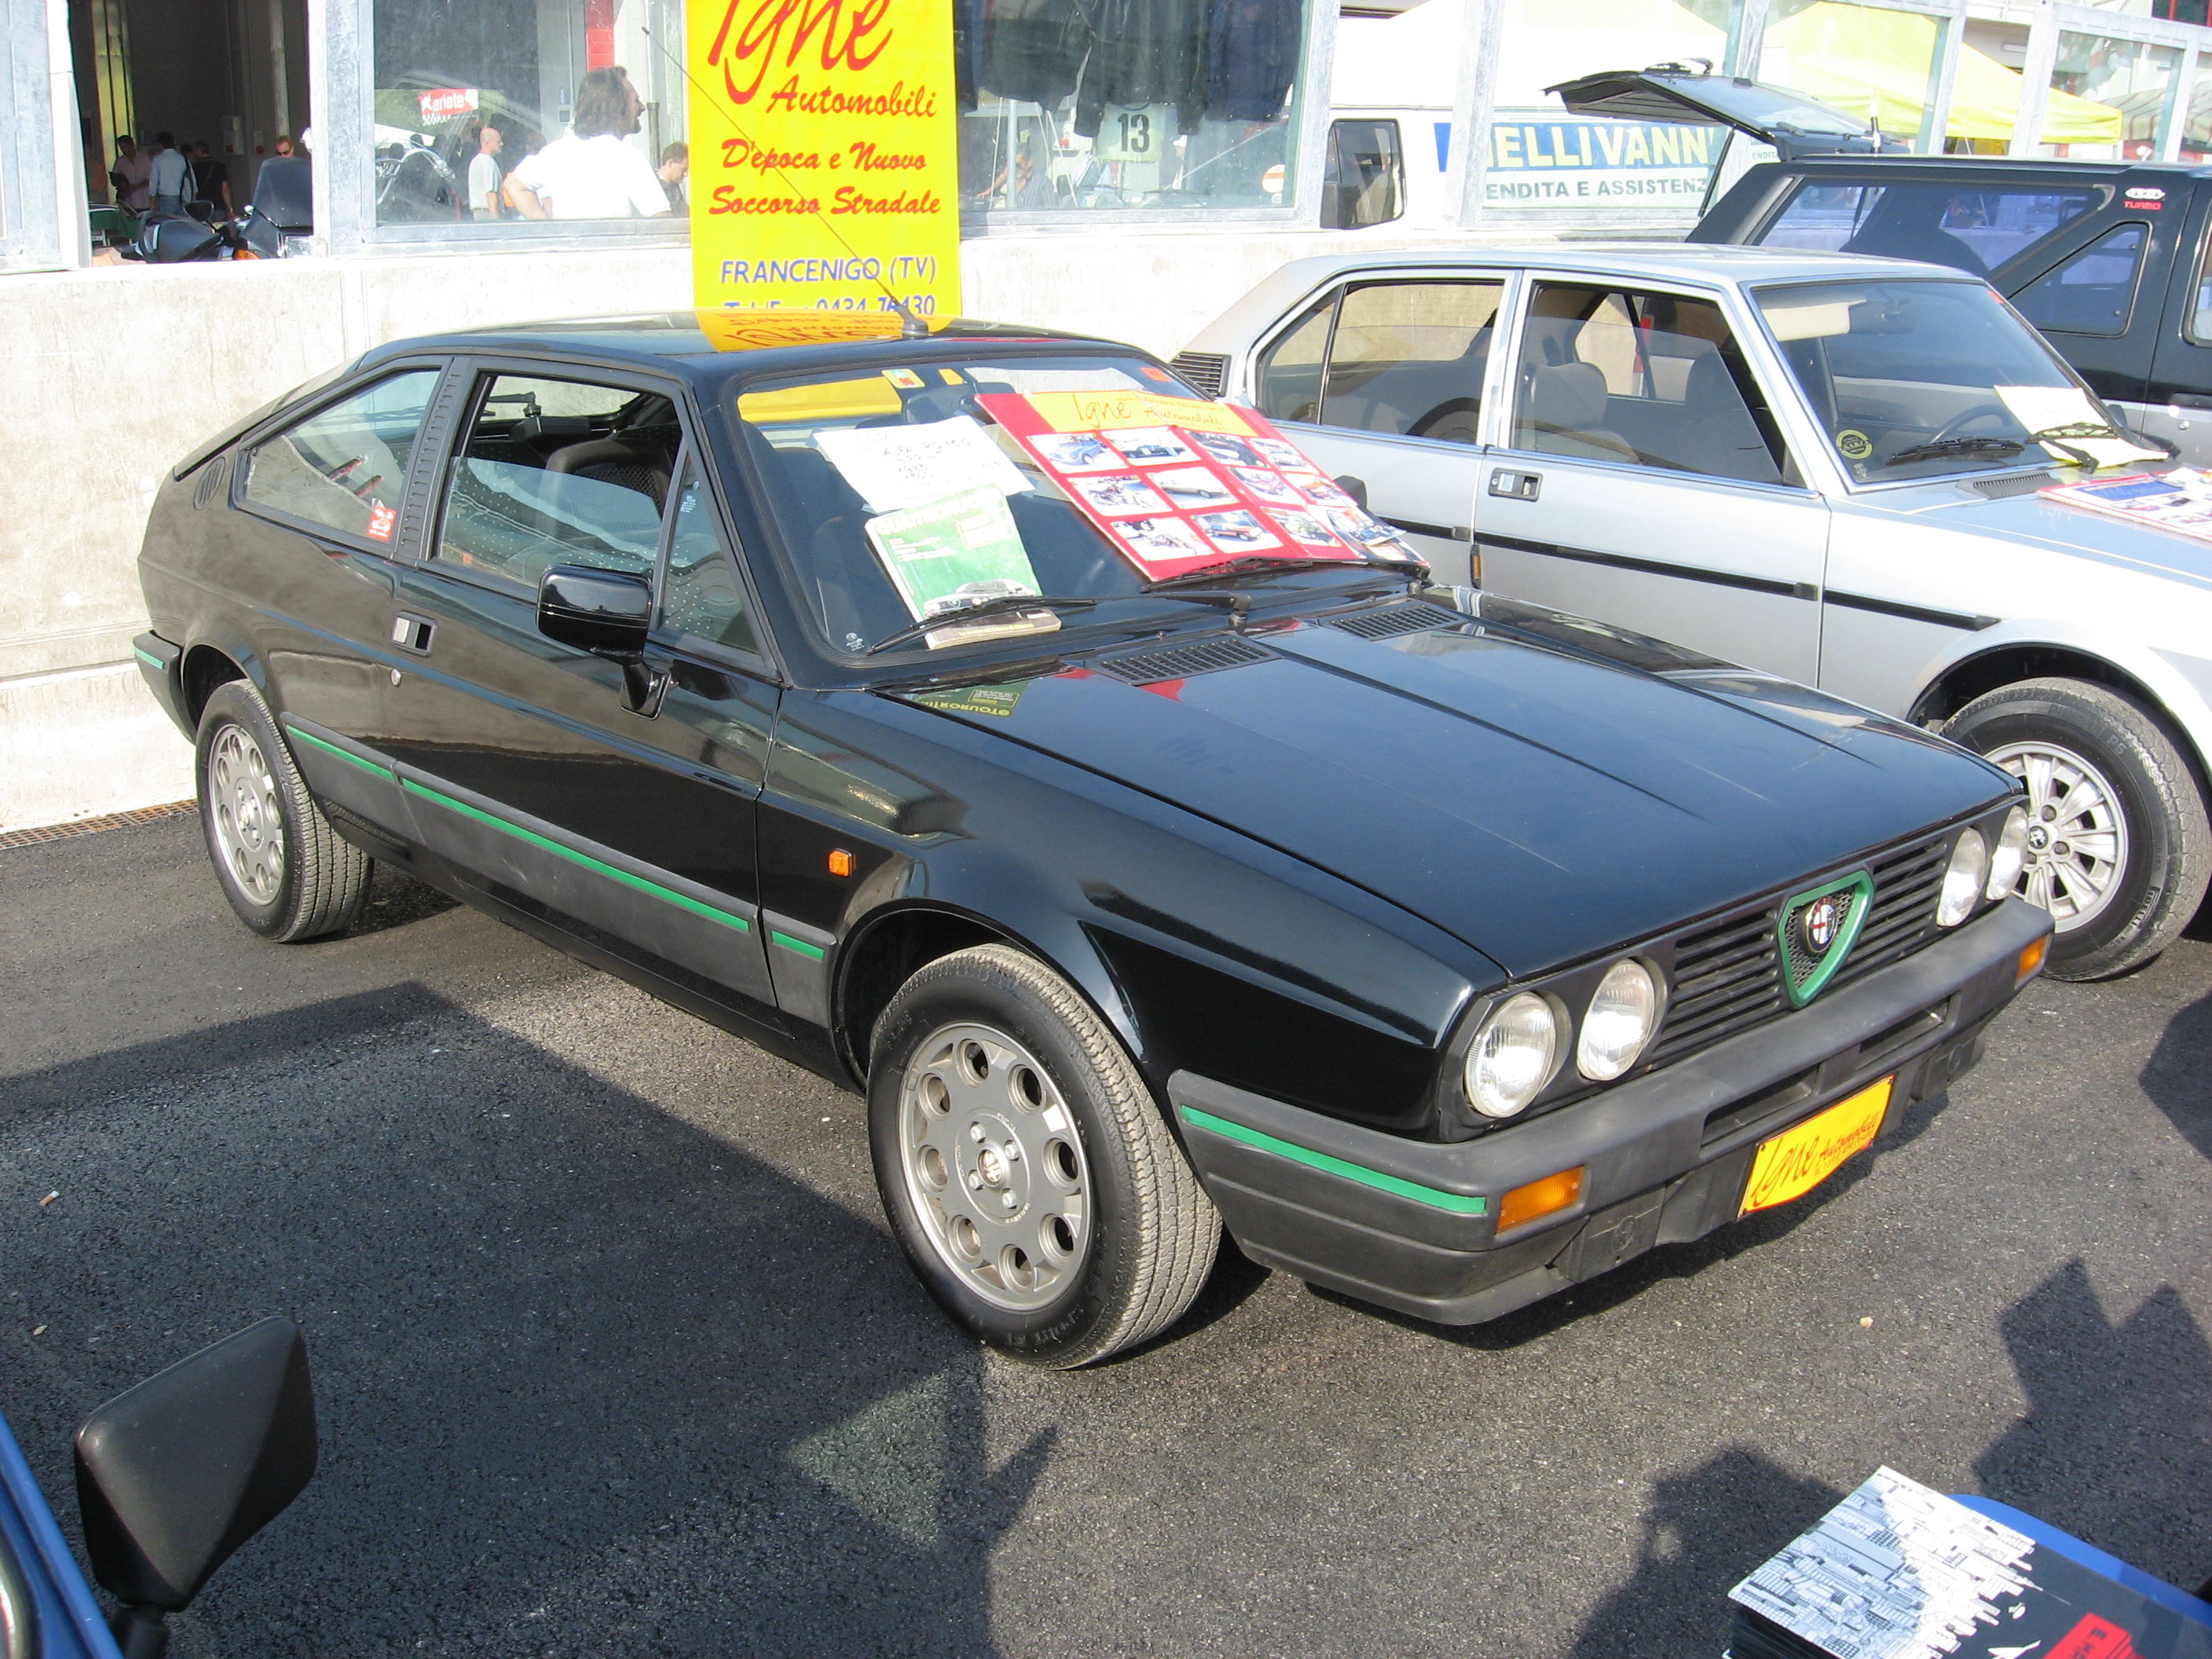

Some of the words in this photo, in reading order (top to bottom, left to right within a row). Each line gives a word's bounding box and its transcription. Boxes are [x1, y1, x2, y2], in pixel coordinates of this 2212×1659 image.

[432, 93, 465, 112] ariete
[767, 75, 937, 118] Automobili
[1117, 113, 1150, 152] 13
[1486, 125, 1716, 167] ELLIVANN
[720, 138, 822, 176] D'epoca
[830, 151, 841, 170] e
[849, 141, 928, 172] Nuovo
[709, 185, 821, 215] Soccorso
[830, 186, 941, 215] Stradale
[1486, 181, 1569, 200] ENDITA
[1577, 179, 1591, 196] E
[1597, 178, 1707, 196] ASSISTENZ
[2123, 200, 2163, 211] TURBO
[721, 257, 880, 284] FRANCENIGO
[889, 256, 937, 285] (TV)
